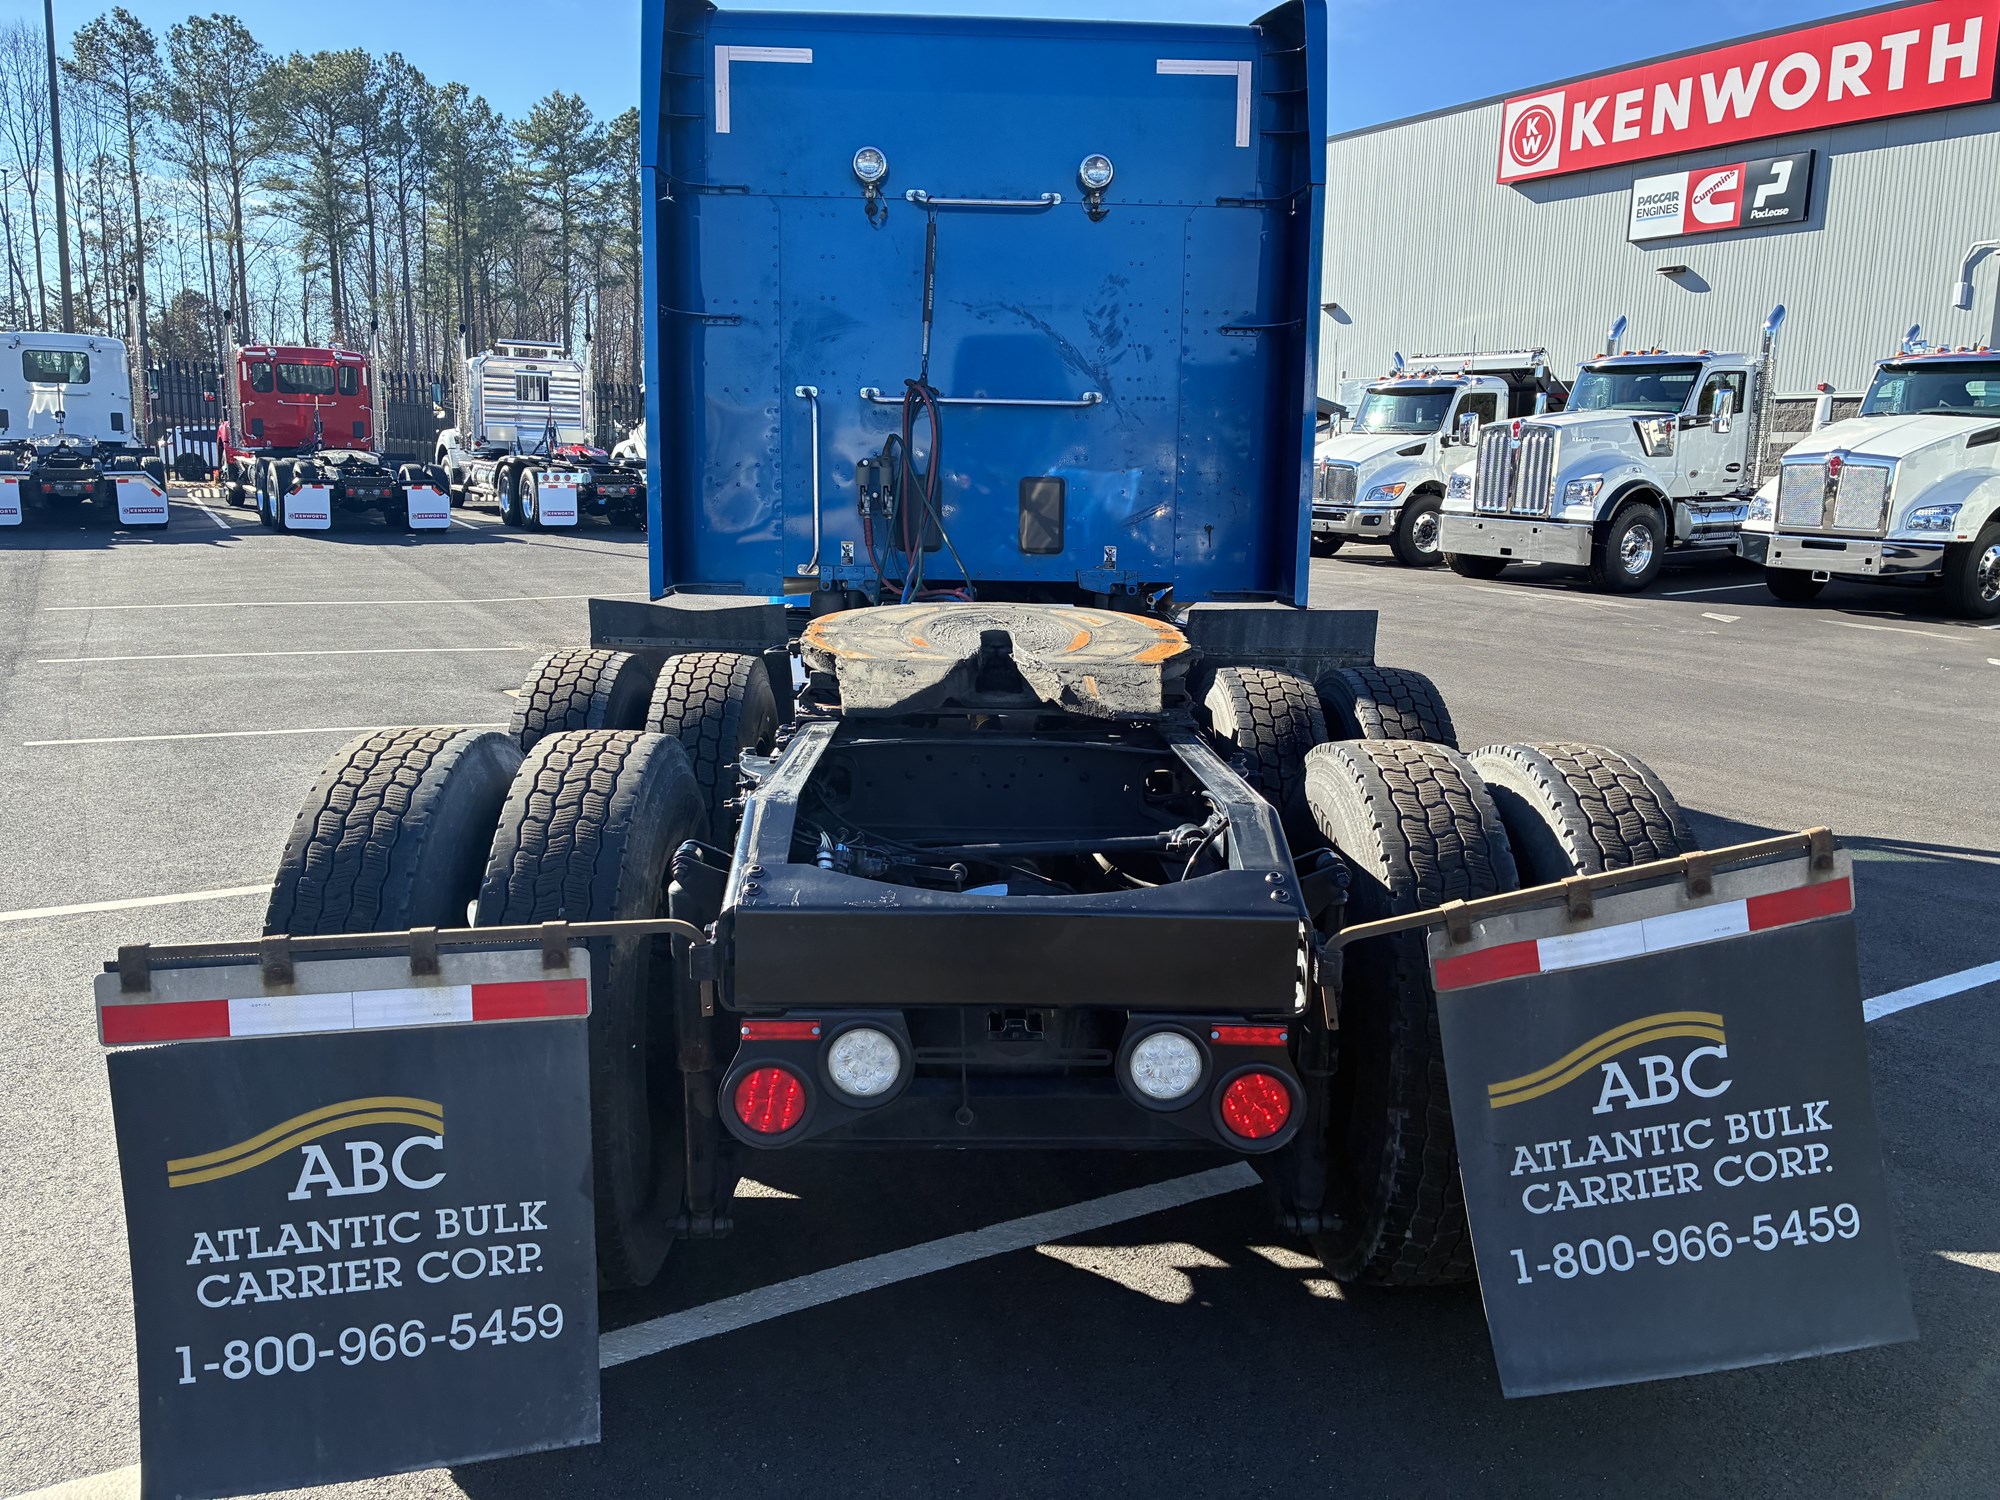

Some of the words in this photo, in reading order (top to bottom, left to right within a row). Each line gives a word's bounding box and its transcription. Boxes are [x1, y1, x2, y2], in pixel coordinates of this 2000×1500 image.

[1569, 16, 1984, 151] KENWORTH
[1636, 202, 1679, 219] ENGINES
[1637, 190, 1680, 207] PACCAR
[1692, 169, 1737, 206] Cummins
[1749, 206, 1790, 220] PacLease
[1592, 1045, 1733, 1115] ABC
[288, 1136, 447, 1201] ABC
[1511, 1119, 1715, 1176] ATLANTIC
[1724, 1101, 1833, 1145] BULK
[1522, 1163, 1703, 1214] CARRIER
[1713, 1144, 1834, 1187] CORP.
[186, 1212, 421, 1266] ATLANTIC
[436, 1201, 548, 1239] BULK
[1510, 1204, 1860, 1285] 1-800-966-5459
[197, 1257, 403, 1308] CARRIER
[417, 1243, 543, 1284] CORP.
[175, 1304, 564, 1385] 1-800-966-5459
